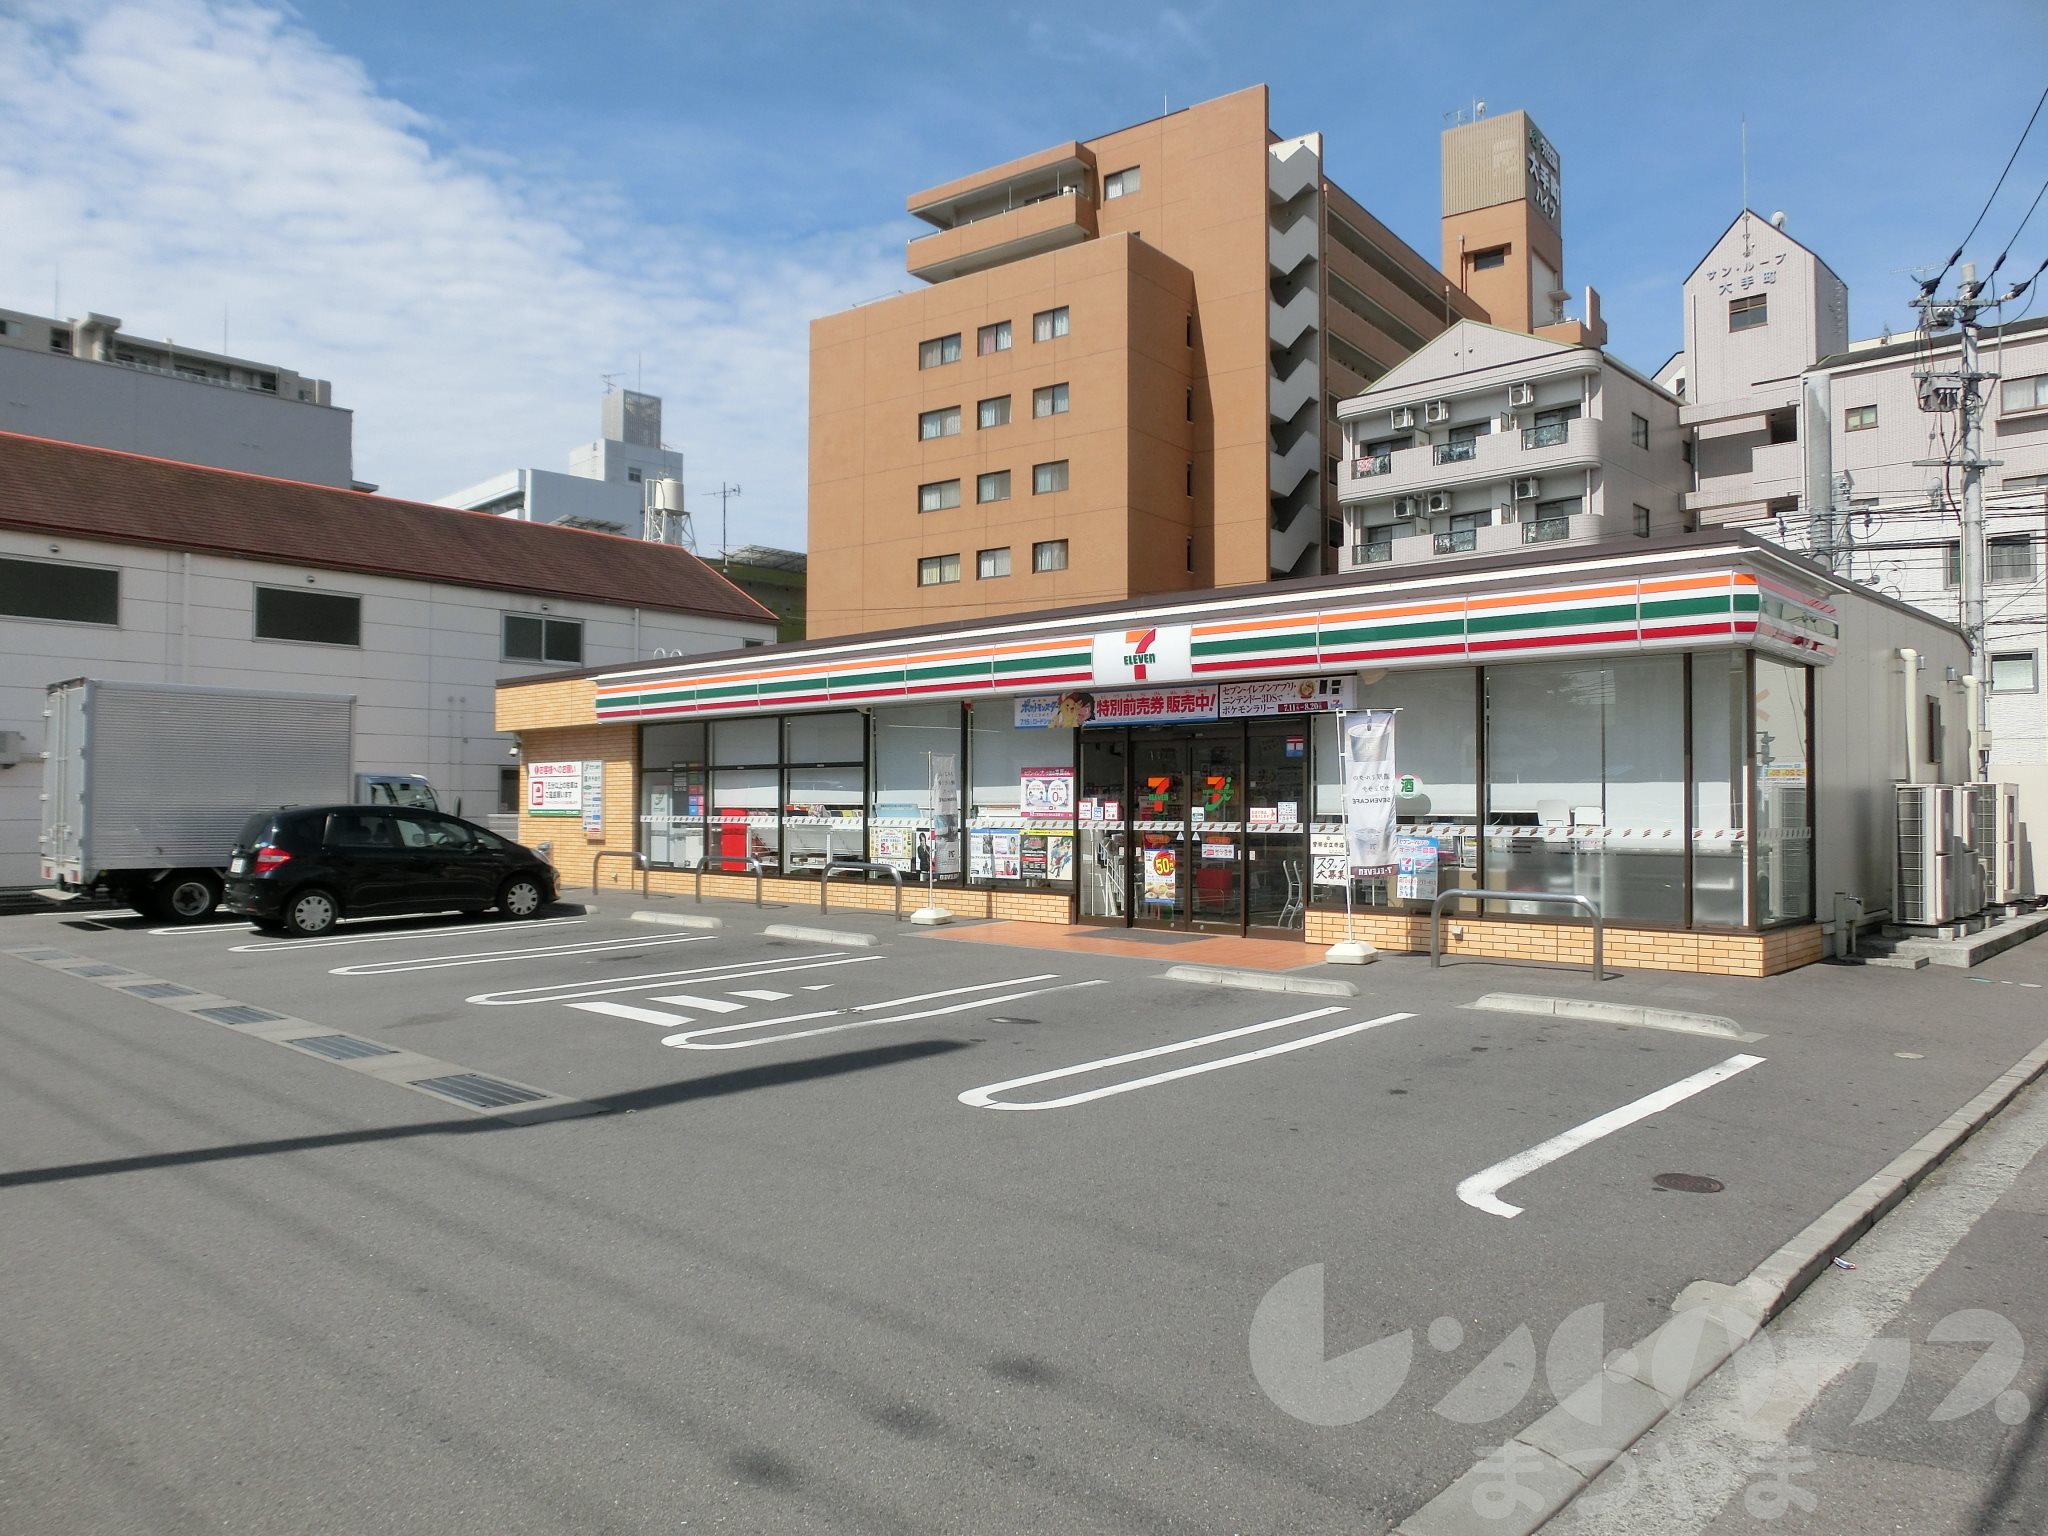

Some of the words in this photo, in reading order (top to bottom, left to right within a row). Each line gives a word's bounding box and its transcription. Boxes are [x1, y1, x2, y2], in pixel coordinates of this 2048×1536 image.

[1718, 270, 1777, 296] 大手町
[1125, 628, 1156, 680] 7
[1096, 696, 1164, 718] 特別前売券
[1222, 703, 1275, 715] ポケモンラリー
[1400, 778, 1415, 793] 酒
[1315, 869, 1347, 880] 大募集
